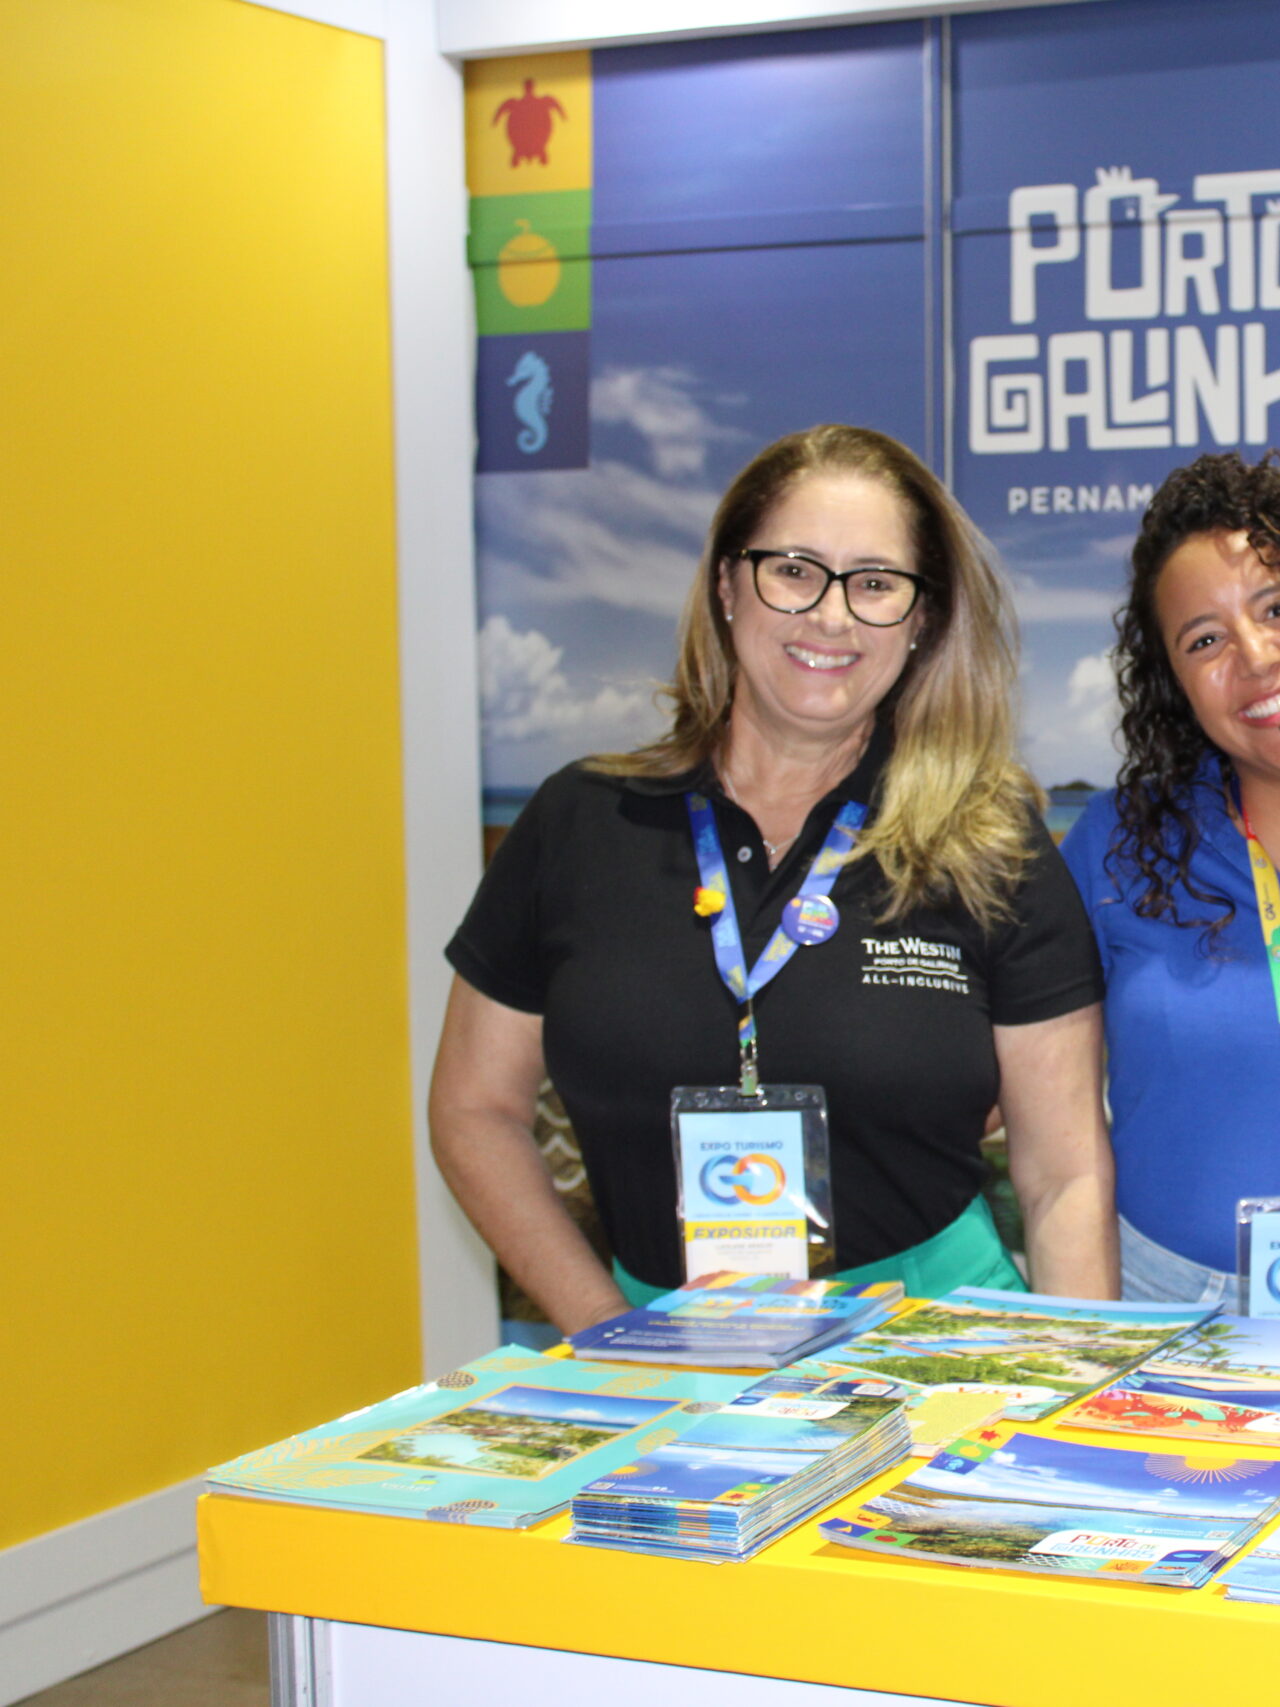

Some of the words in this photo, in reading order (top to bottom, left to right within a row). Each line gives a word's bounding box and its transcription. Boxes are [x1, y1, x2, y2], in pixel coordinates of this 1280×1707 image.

[861, 938, 900, 955] THE
[899, 937, 962, 961] WESTIN
[862, 973, 970, 995] ALL-INCLUSIVE
[700, 1142, 731, 1152] EXPO
[734, 1140, 784, 1151] TURISMO
[693, 1226, 797, 1240] EXPOSITOR
[1070, 1534, 1138, 1549] PORTO
